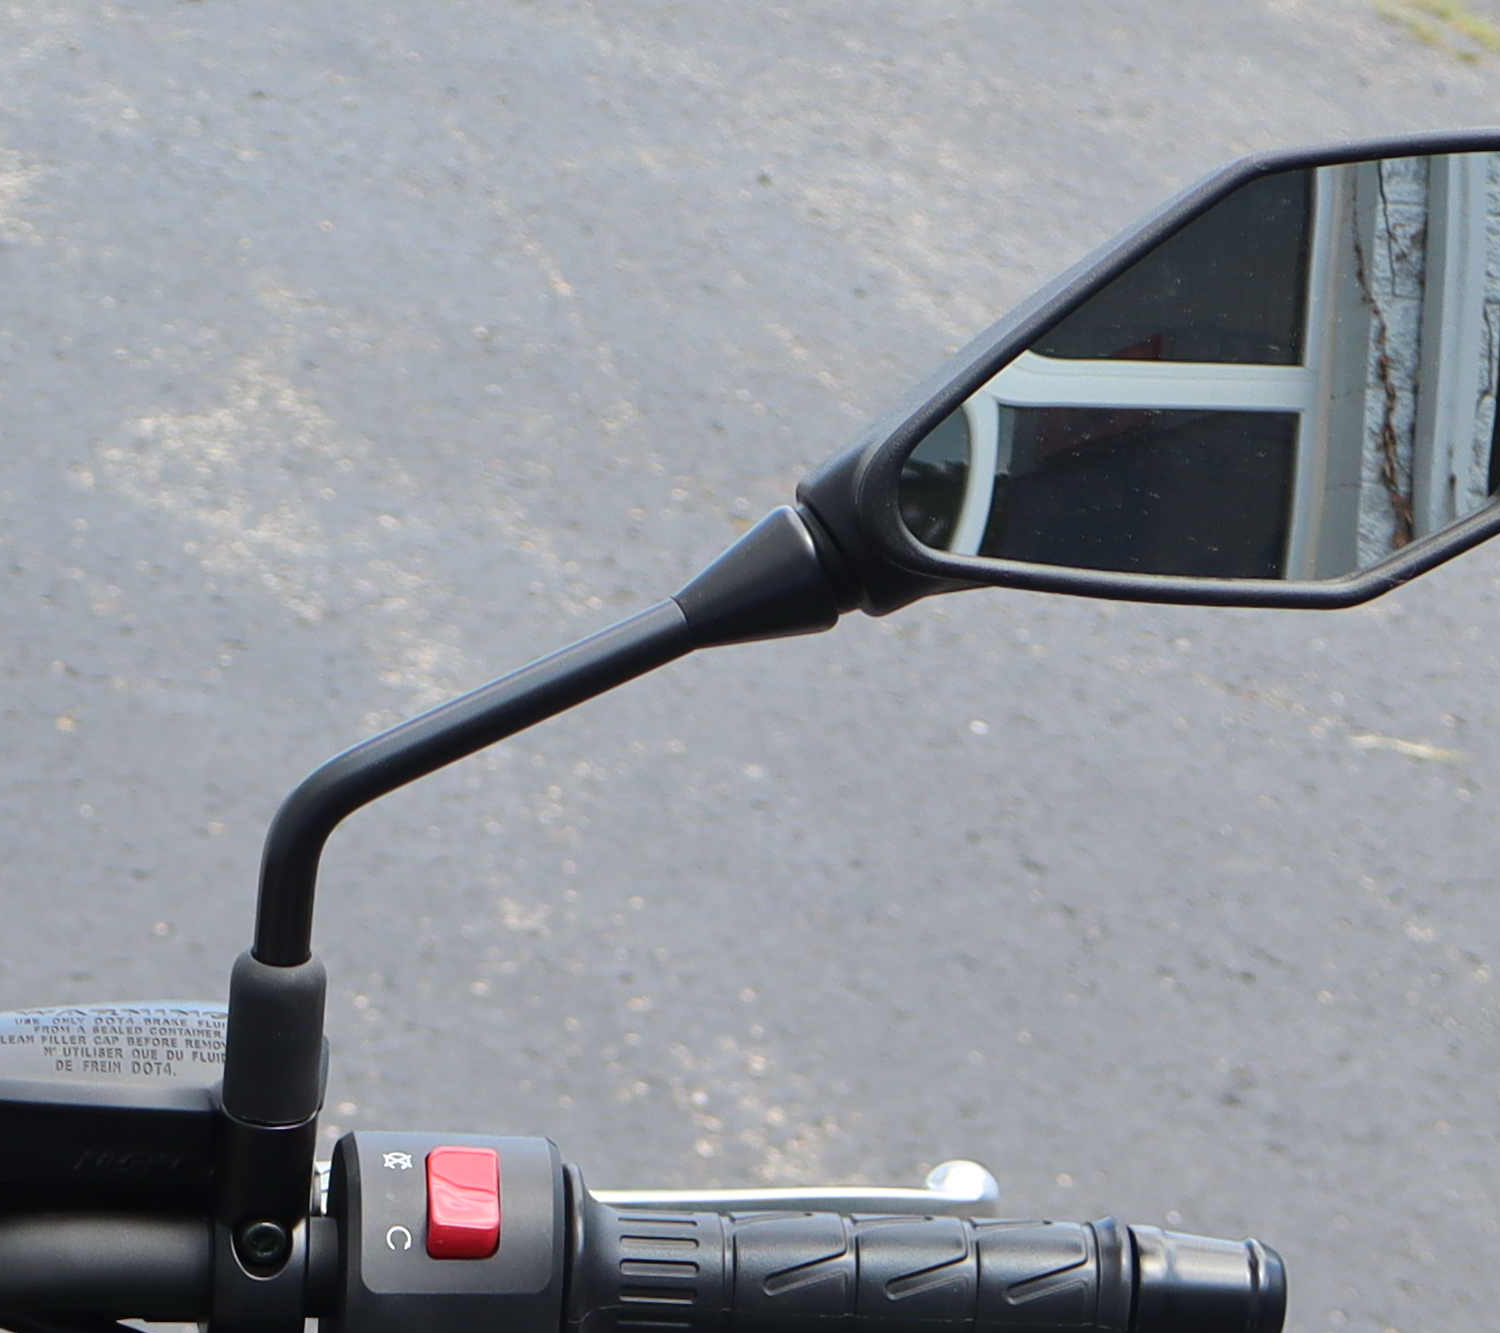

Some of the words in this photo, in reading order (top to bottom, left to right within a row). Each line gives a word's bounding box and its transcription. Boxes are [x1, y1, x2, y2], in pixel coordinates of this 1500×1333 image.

[94, 1017, 134, 1026] DOT4
[143, 1018, 188, 1027] BRAKE
[197, 1020, 227, 1029] FLUI
[34, 1026, 70, 1034] FROM
[92, 1026, 142, 1035] SEALED
[41, 1035, 86, 1045] FILLER
[94, 1036, 119, 1046] CAP
[127, 1037, 178, 1048] BEFORE
[185, 1038, 227, 1050] REMOV
[131, 1048, 158, 1060] QUE
[166, 1050, 184, 1061] DU
[55, 1060, 73, 1072] DE
[82, 1060, 121, 1073] FREIN
